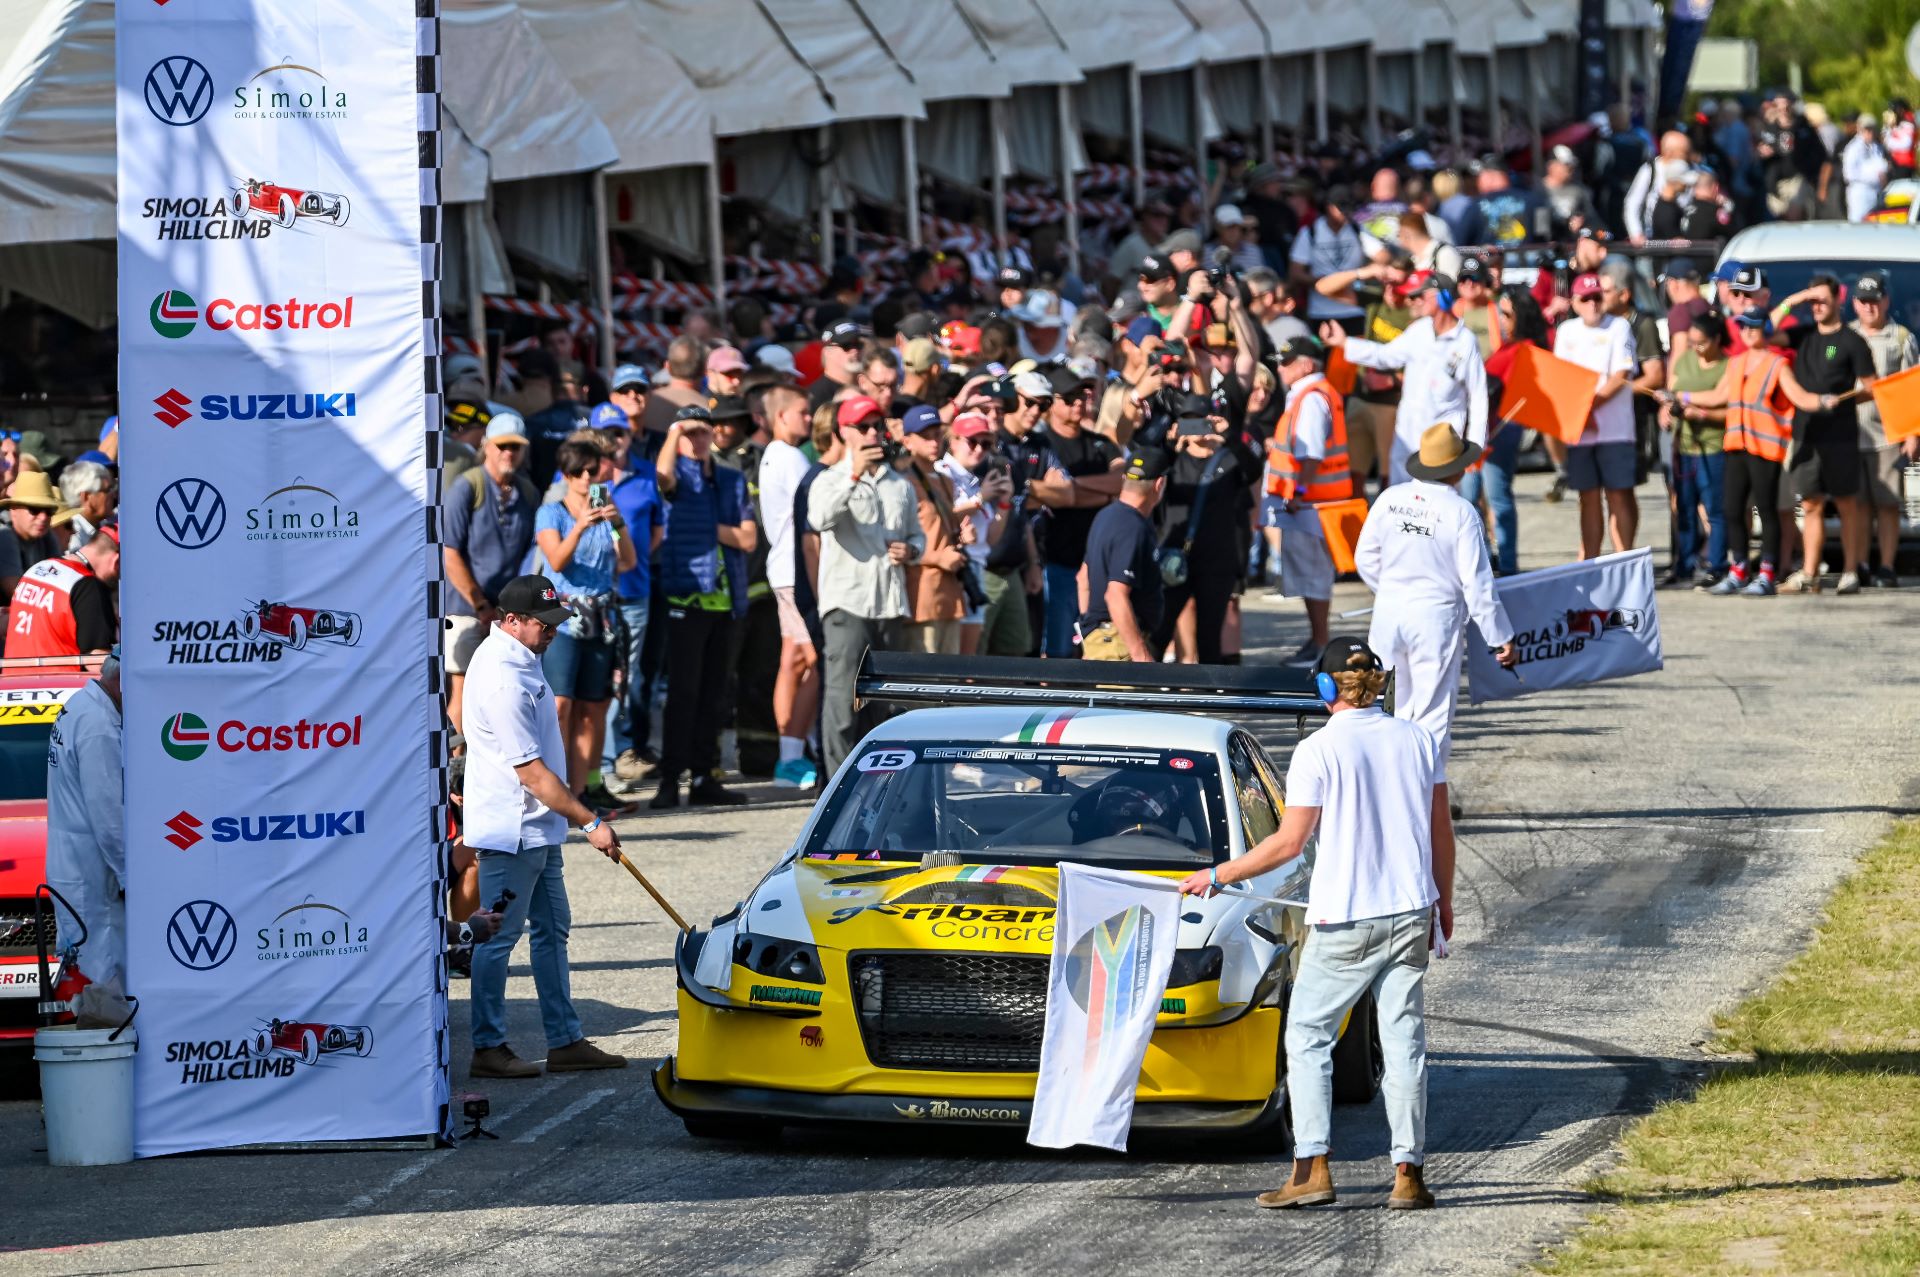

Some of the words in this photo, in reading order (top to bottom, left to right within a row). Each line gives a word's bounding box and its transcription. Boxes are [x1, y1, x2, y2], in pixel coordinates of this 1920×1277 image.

[235, 86, 347, 108] Simola
[315, 111, 348, 119] ESTATE
[142, 198, 227, 218] SIMOLA
[307, 199, 318, 209] 14
[157, 220, 271, 240] HILLCLIMB
[205, 296, 353, 331] Castrol
[201, 393, 356, 420] SUZUKI
[246, 505, 359, 530] Simola
[246, 532, 270, 541] GOLF
[272, 532, 279, 540] &
[280, 531, 324, 540] COUNTRY
[327, 530, 360, 538] ESTATE
[14, 610, 33, 635] 21
[152, 620, 239, 641] SIMOLA
[319, 617, 331, 629] 14
[168, 642, 283, 664] HILLCLIMB
[1518, 636, 1585, 665] LLCLIMB
[216, 714, 362, 752] Castrol
[869, 753, 904, 768] 15
[211, 809, 365, 843] SUZUKI
[256, 922, 368, 950] Simola
[931, 920, 1055, 941] Concre
[257, 952, 281, 961] GOLF
[283, 951, 290, 959] &
[292, 948, 335, 959] COUNTRY
[338, 944, 369, 955] ESTATE
[329, 1033, 341, 1045] 14
[165, 1040, 250, 1062] SIMOLA
[180, 1057, 296, 1084] HILLCLIMB
